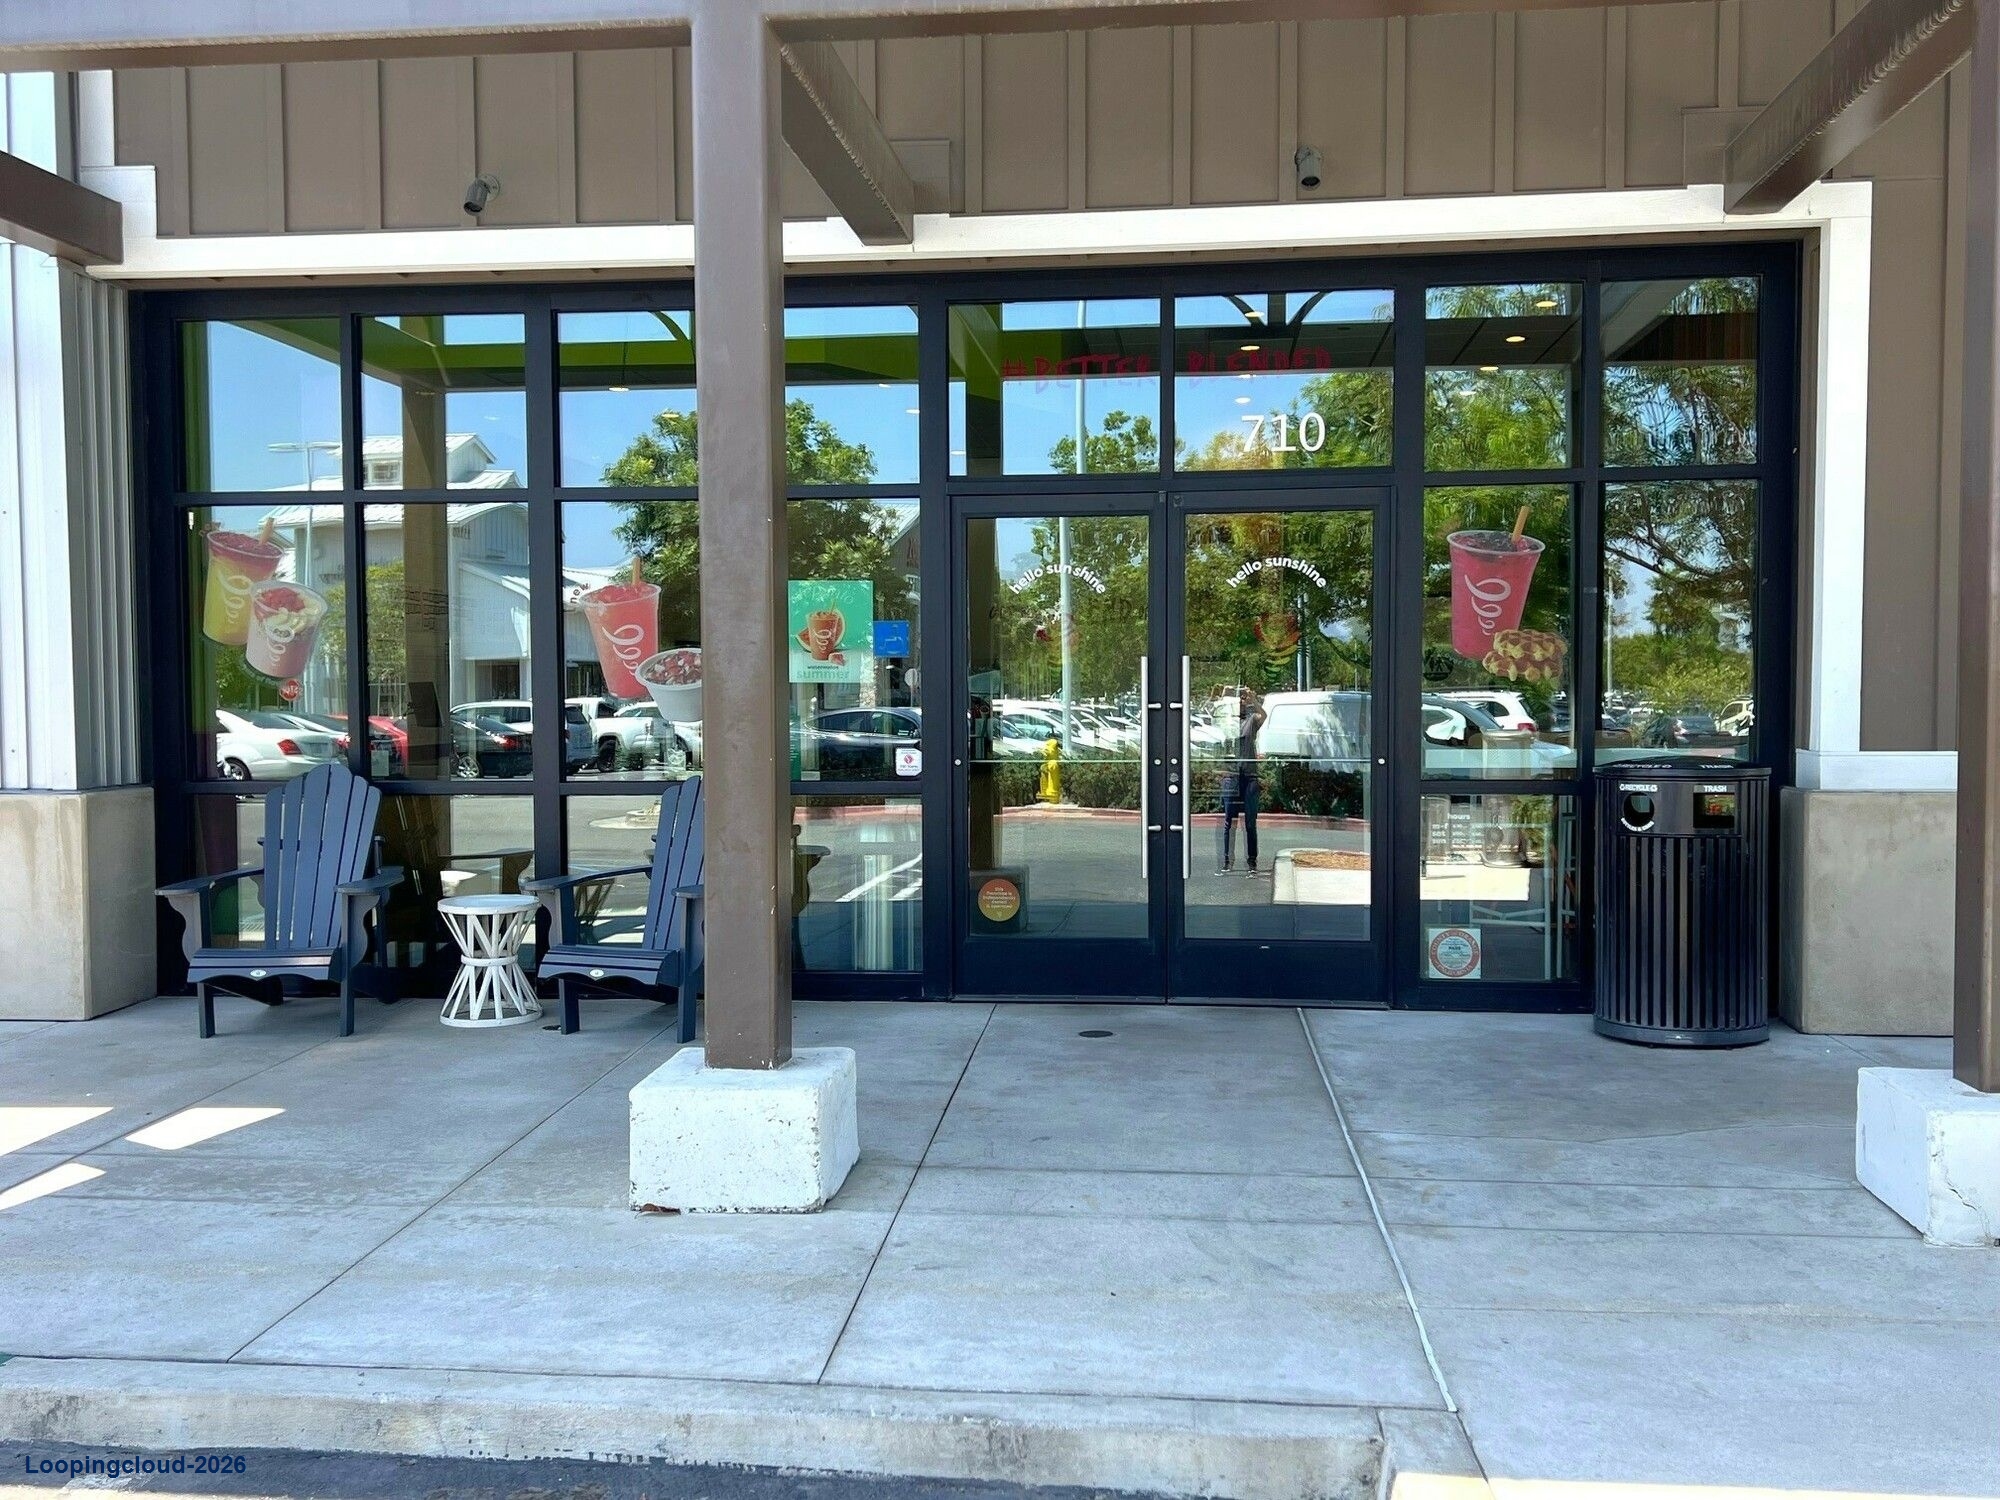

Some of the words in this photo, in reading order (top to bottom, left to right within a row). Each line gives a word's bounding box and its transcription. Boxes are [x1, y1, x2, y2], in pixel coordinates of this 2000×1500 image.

[1241, 412, 1326, 452] 710
[1009, 567, 1044, 595] hello
[1046, 563, 1106, 594] sunshine
[1226, 561, 1263, 588] hello
[1265, 557, 1327, 588] sunshine
[1703, 785, 1728, 793] TRASH
